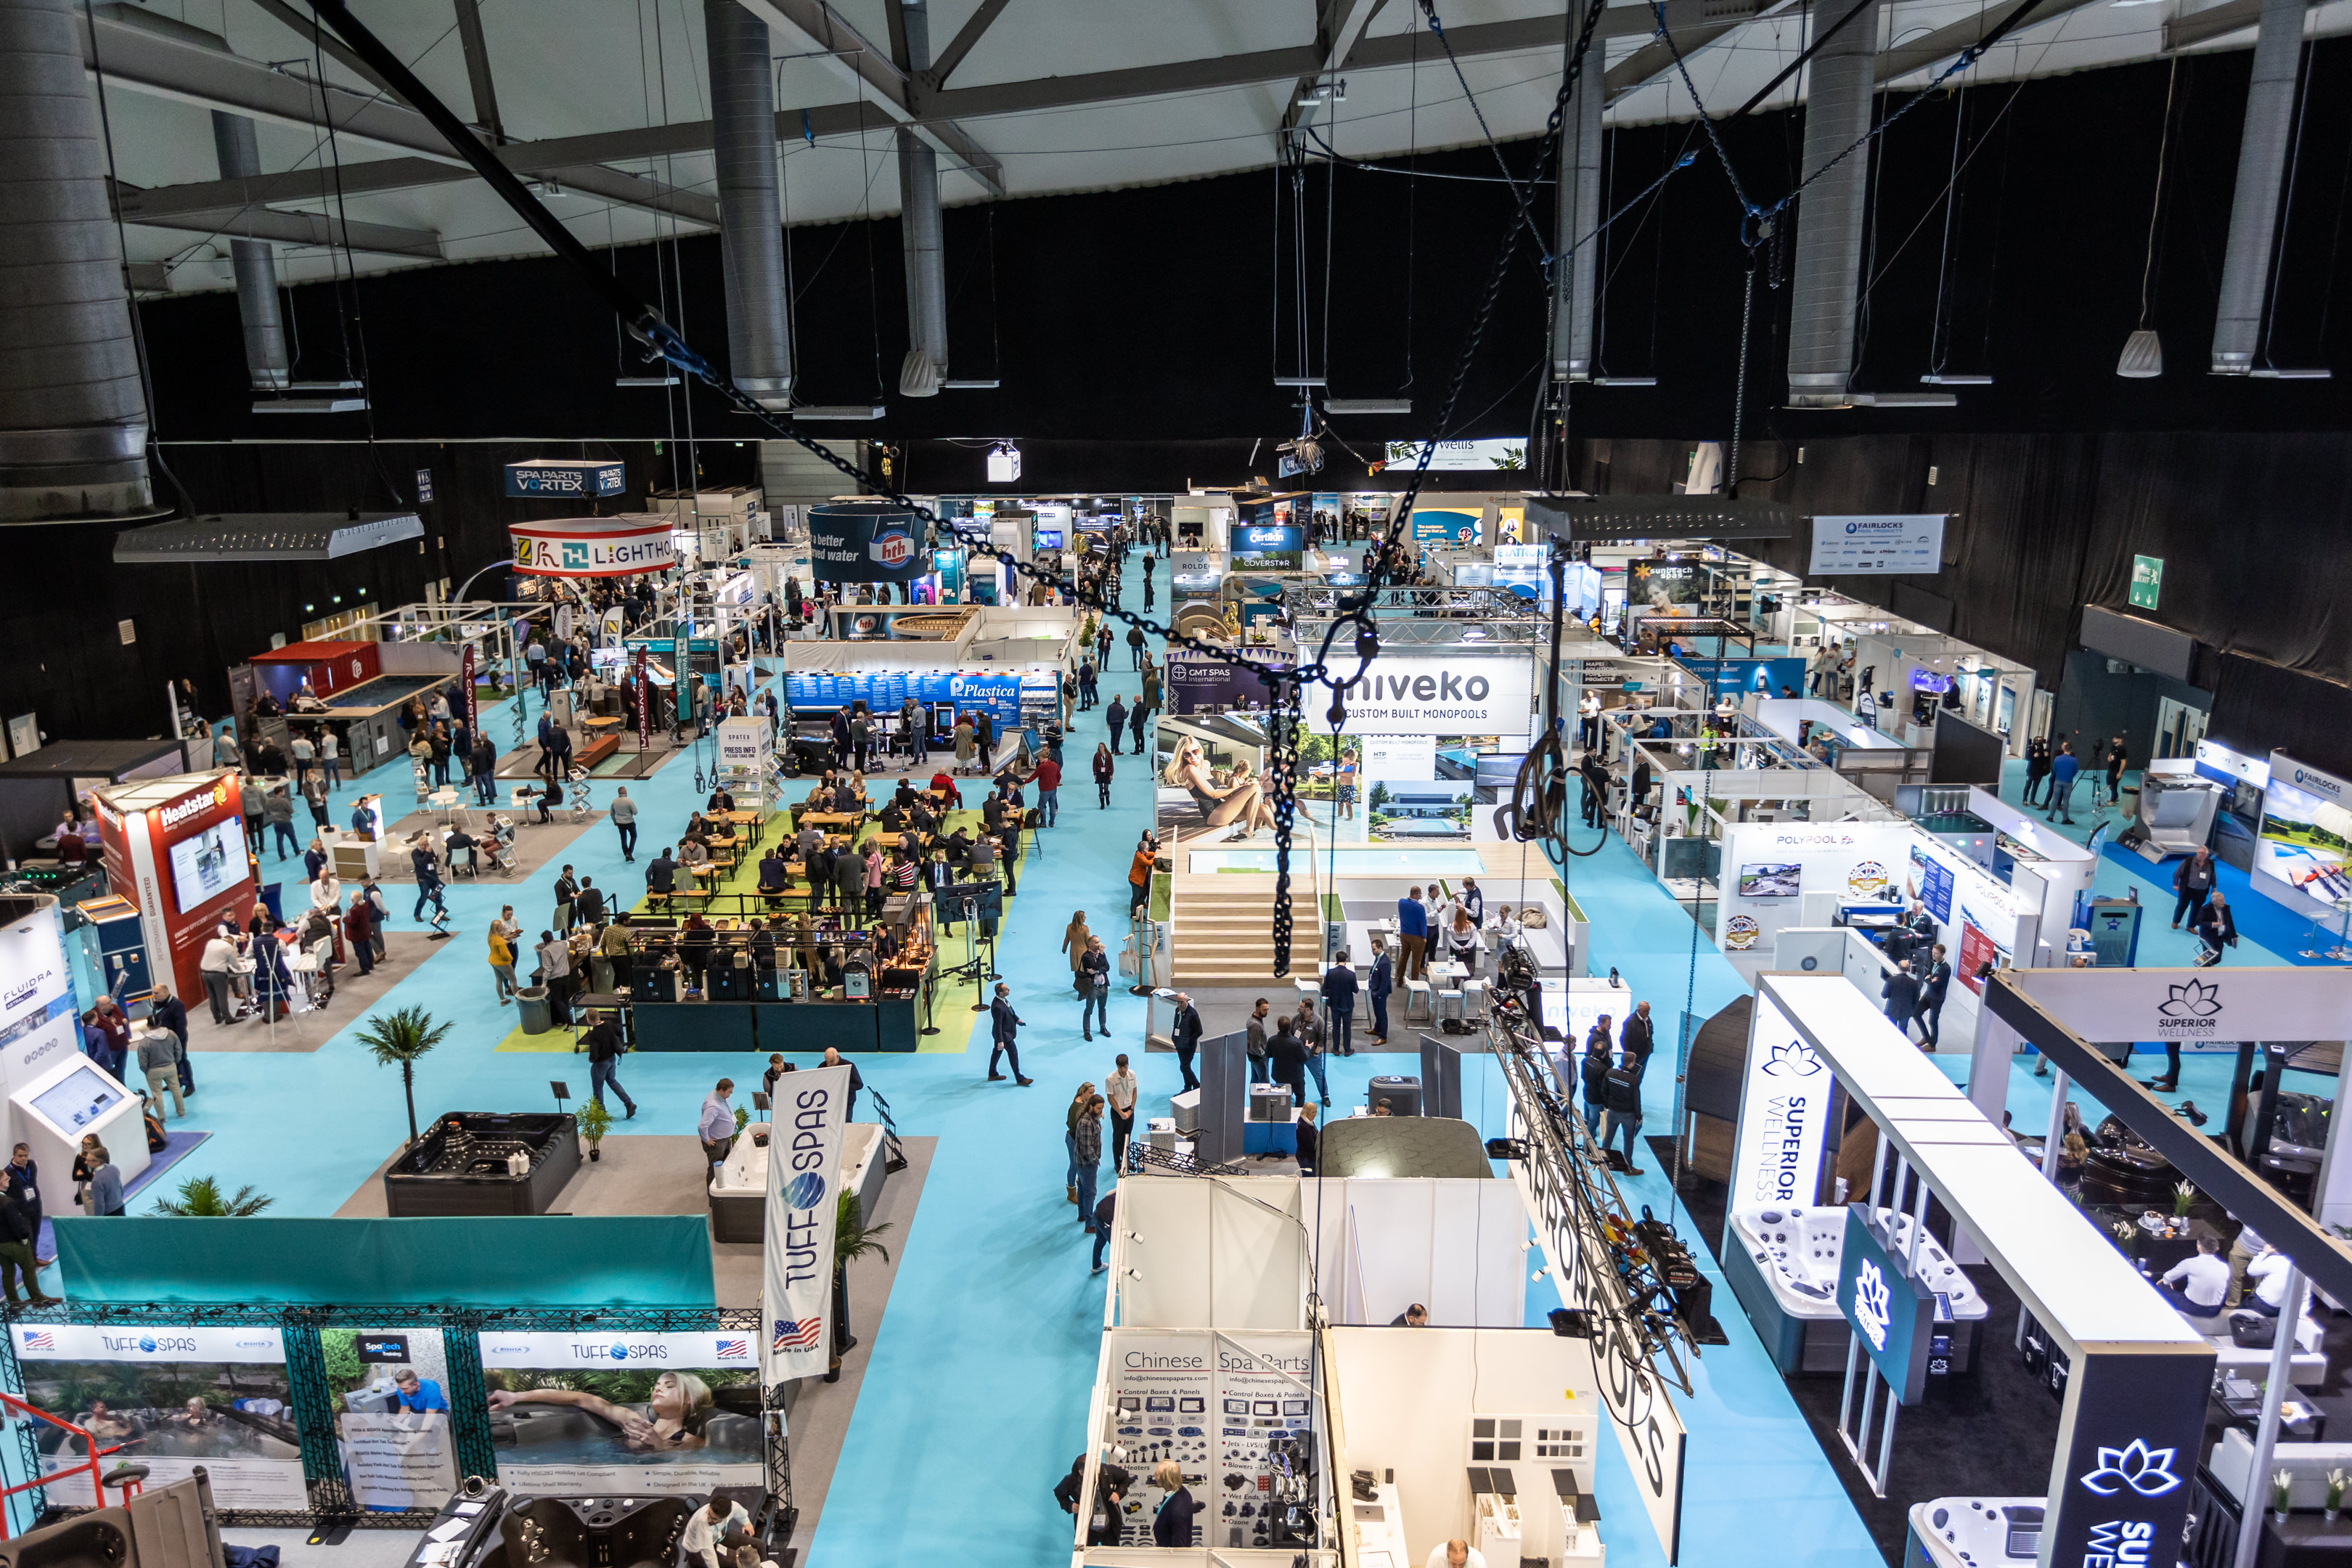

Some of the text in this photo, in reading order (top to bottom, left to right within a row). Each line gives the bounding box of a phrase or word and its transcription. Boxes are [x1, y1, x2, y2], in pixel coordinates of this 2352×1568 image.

[516, 470, 582, 480] SPA PARTS
[517, 479, 582, 491] VORTEX
[600, 476, 621, 491] VORTEX
[817, 534, 845, 547] better
[1249, 532, 1284, 543] Certikin
[828, 550, 859, 562] water
[882, 540, 905, 560] hth
[964, 684, 1015, 698] Plastica
[1346, 671, 1490, 701] niveko
[466, 678, 476, 738] coverse
[1346, 709, 1487, 719] CUSTOM BUILT MONOPOOLS
[2304, 772, 2340, 793] FAIRLOCKS
[160, 791, 215, 827] Heatstar
[144, 877, 155, 916] GUARANTEED
[4, 970, 52, 1002] FLUIDRA
[2158, 1018, 2216, 1028] SUPERIOR
[2157, 1028, 2215, 1037] WELLNESS
[791, 1089, 829, 1171] SPAS
[1757, 1095, 1786, 1202] WELLNESS
[1776, 1097, 1806, 1201] SUPERIOR
[785, 1209, 819, 1290] TUFF
[102, 1336, 196, 1352] TUFF SPAS
[366, 1342, 401, 1352] SpaTech
[571, 1344, 668, 1359] TUFF SPAS
[804, 1343, 819, 1352] USA
[1125, 1352, 1309, 1373] Chinese Spa Parts
